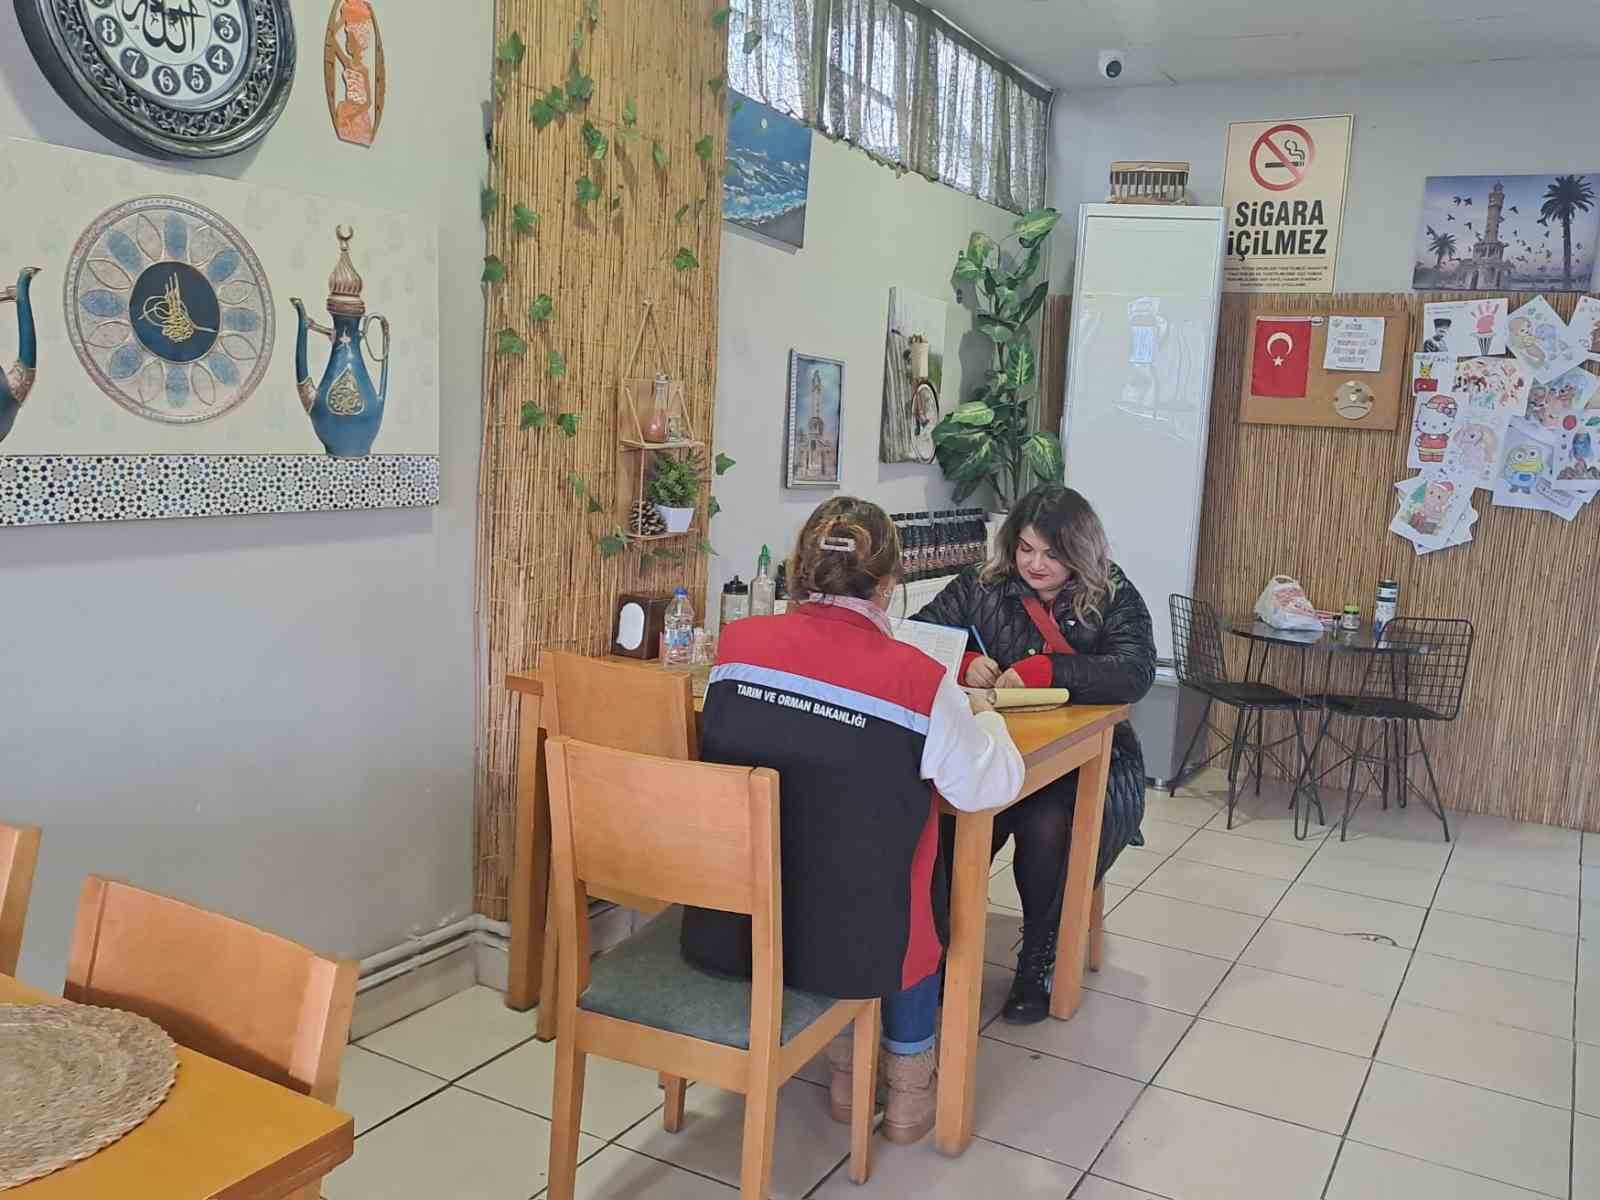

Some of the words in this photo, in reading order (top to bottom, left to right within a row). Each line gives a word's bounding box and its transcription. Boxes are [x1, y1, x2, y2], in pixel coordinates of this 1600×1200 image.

[101, 18, 116, 42] 8
[219, 17, 233, 39] 3
[126, 50, 139, 75] 7
[212, 48, 227, 71] 4
[159, 69, 174, 92] 6
[191, 66, 204, 90] 5
[1235, 200, 1324, 227] SİGARA
[737, 684, 762, 700] TARIM
[764, 691, 776, 703] VE
[778, 694, 812, 712] ORMAN
[813, 703, 867, 729] BAKANLIĞI
